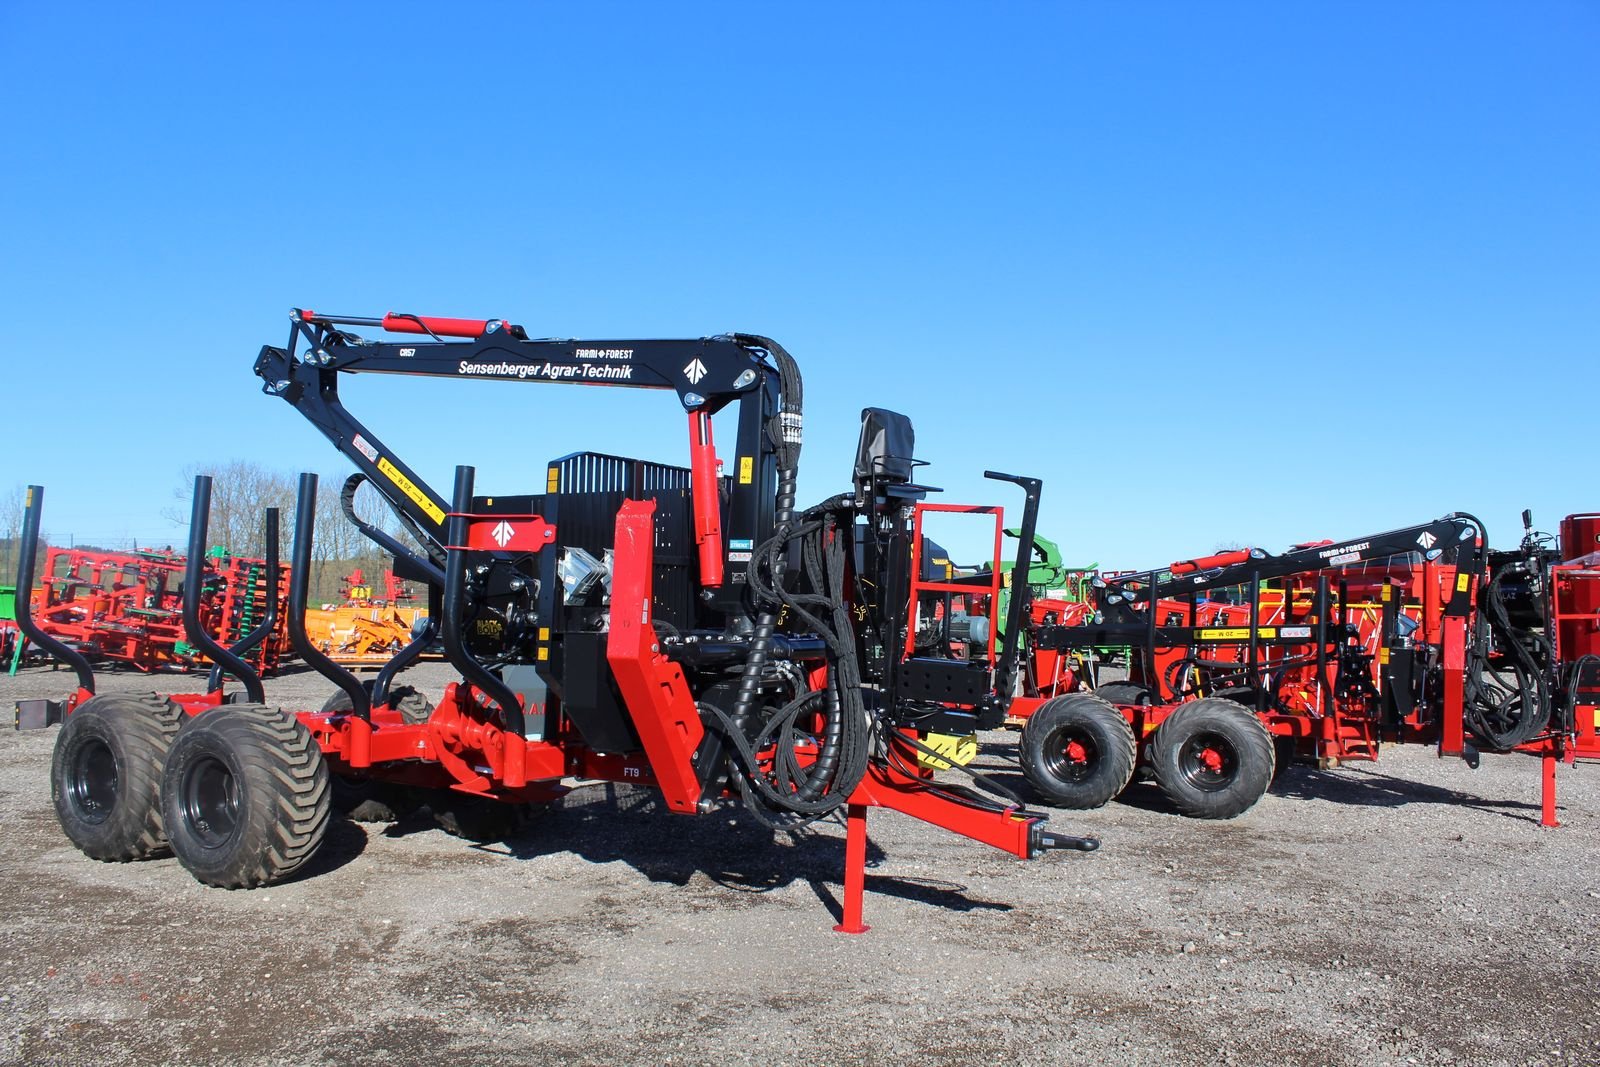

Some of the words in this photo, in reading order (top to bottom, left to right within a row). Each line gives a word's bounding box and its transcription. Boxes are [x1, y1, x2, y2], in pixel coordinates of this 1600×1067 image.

[399, 348, 416, 357] CR57
[575, 349, 598, 359] FARMI
[605, 349, 634, 359] FOREST
[458, 360, 541, 378] Sensenberger
[541, 362, 633, 380] Agrar-Technik
[1319, 549, 1339, 559] FARMI
[1345, 541, 1370, 553] FOREST
[477, 626, 499, 635] BOLD
[623, 767, 640, 777] FT9
